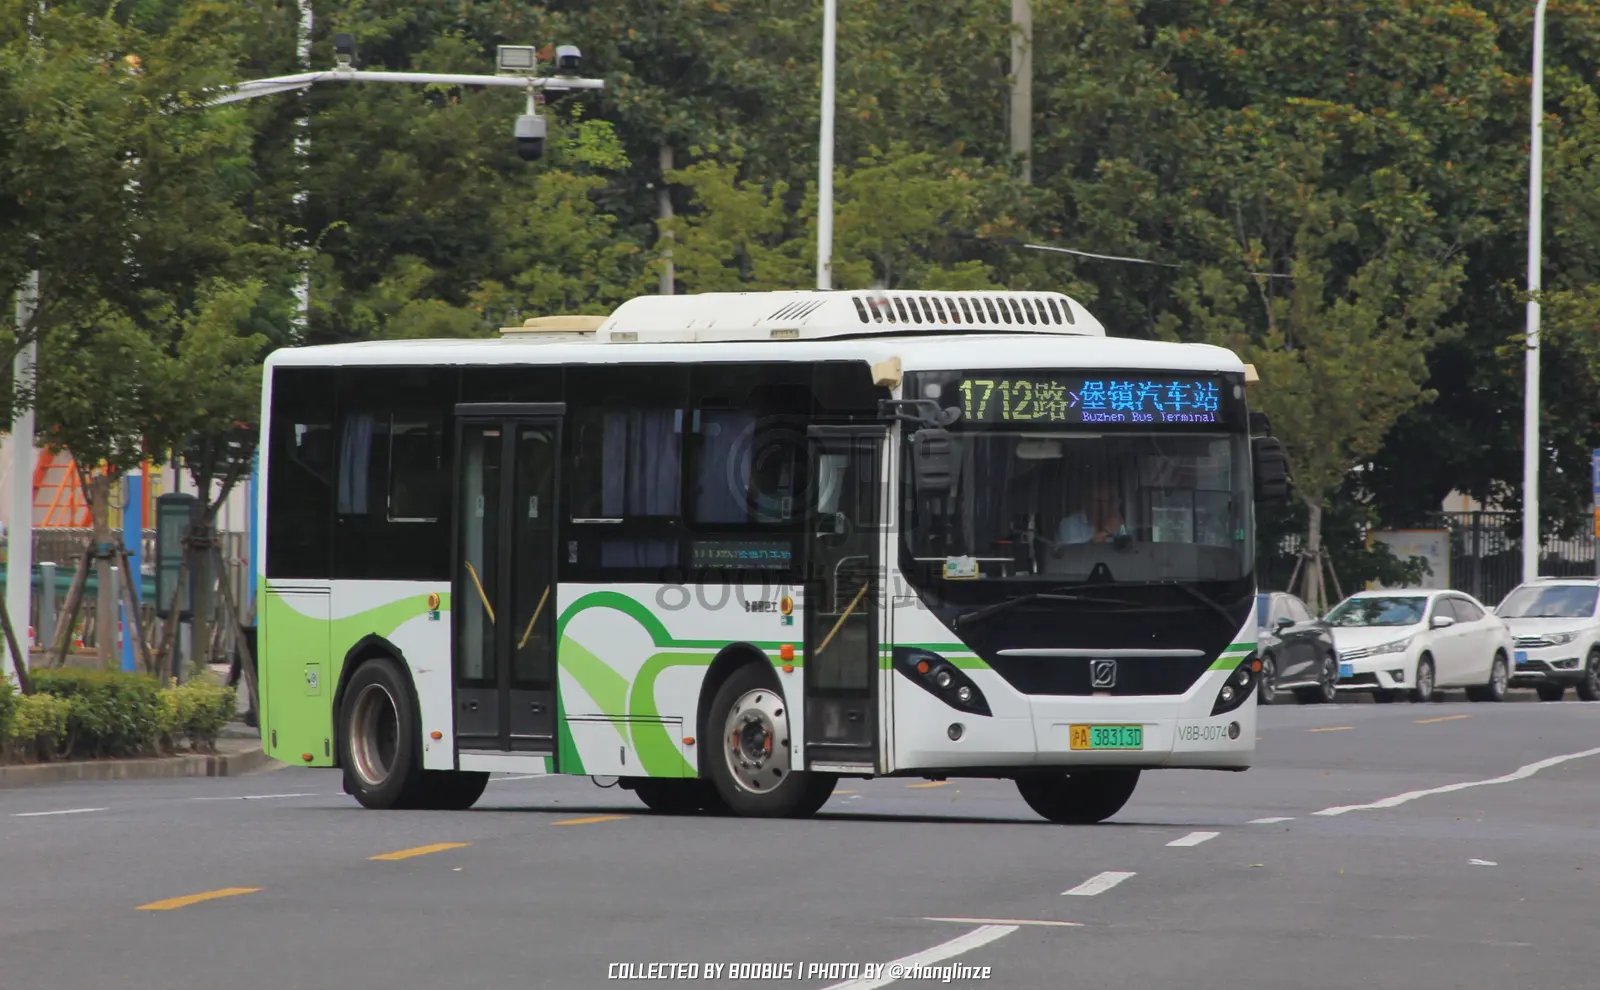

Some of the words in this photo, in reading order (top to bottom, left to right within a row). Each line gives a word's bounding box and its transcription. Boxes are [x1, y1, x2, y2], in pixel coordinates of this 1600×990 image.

[959, 380, 1069, 420] 1712路
[1080, 381, 1219, 411] 堡镇汽车站
[1082, 411, 1126, 422] Buzhen
[1132, 411, 1154, 422] Bus
[1160, 411, 1216, 422] Terminal
[1178, 725, 1228, 741] V8B-0074
